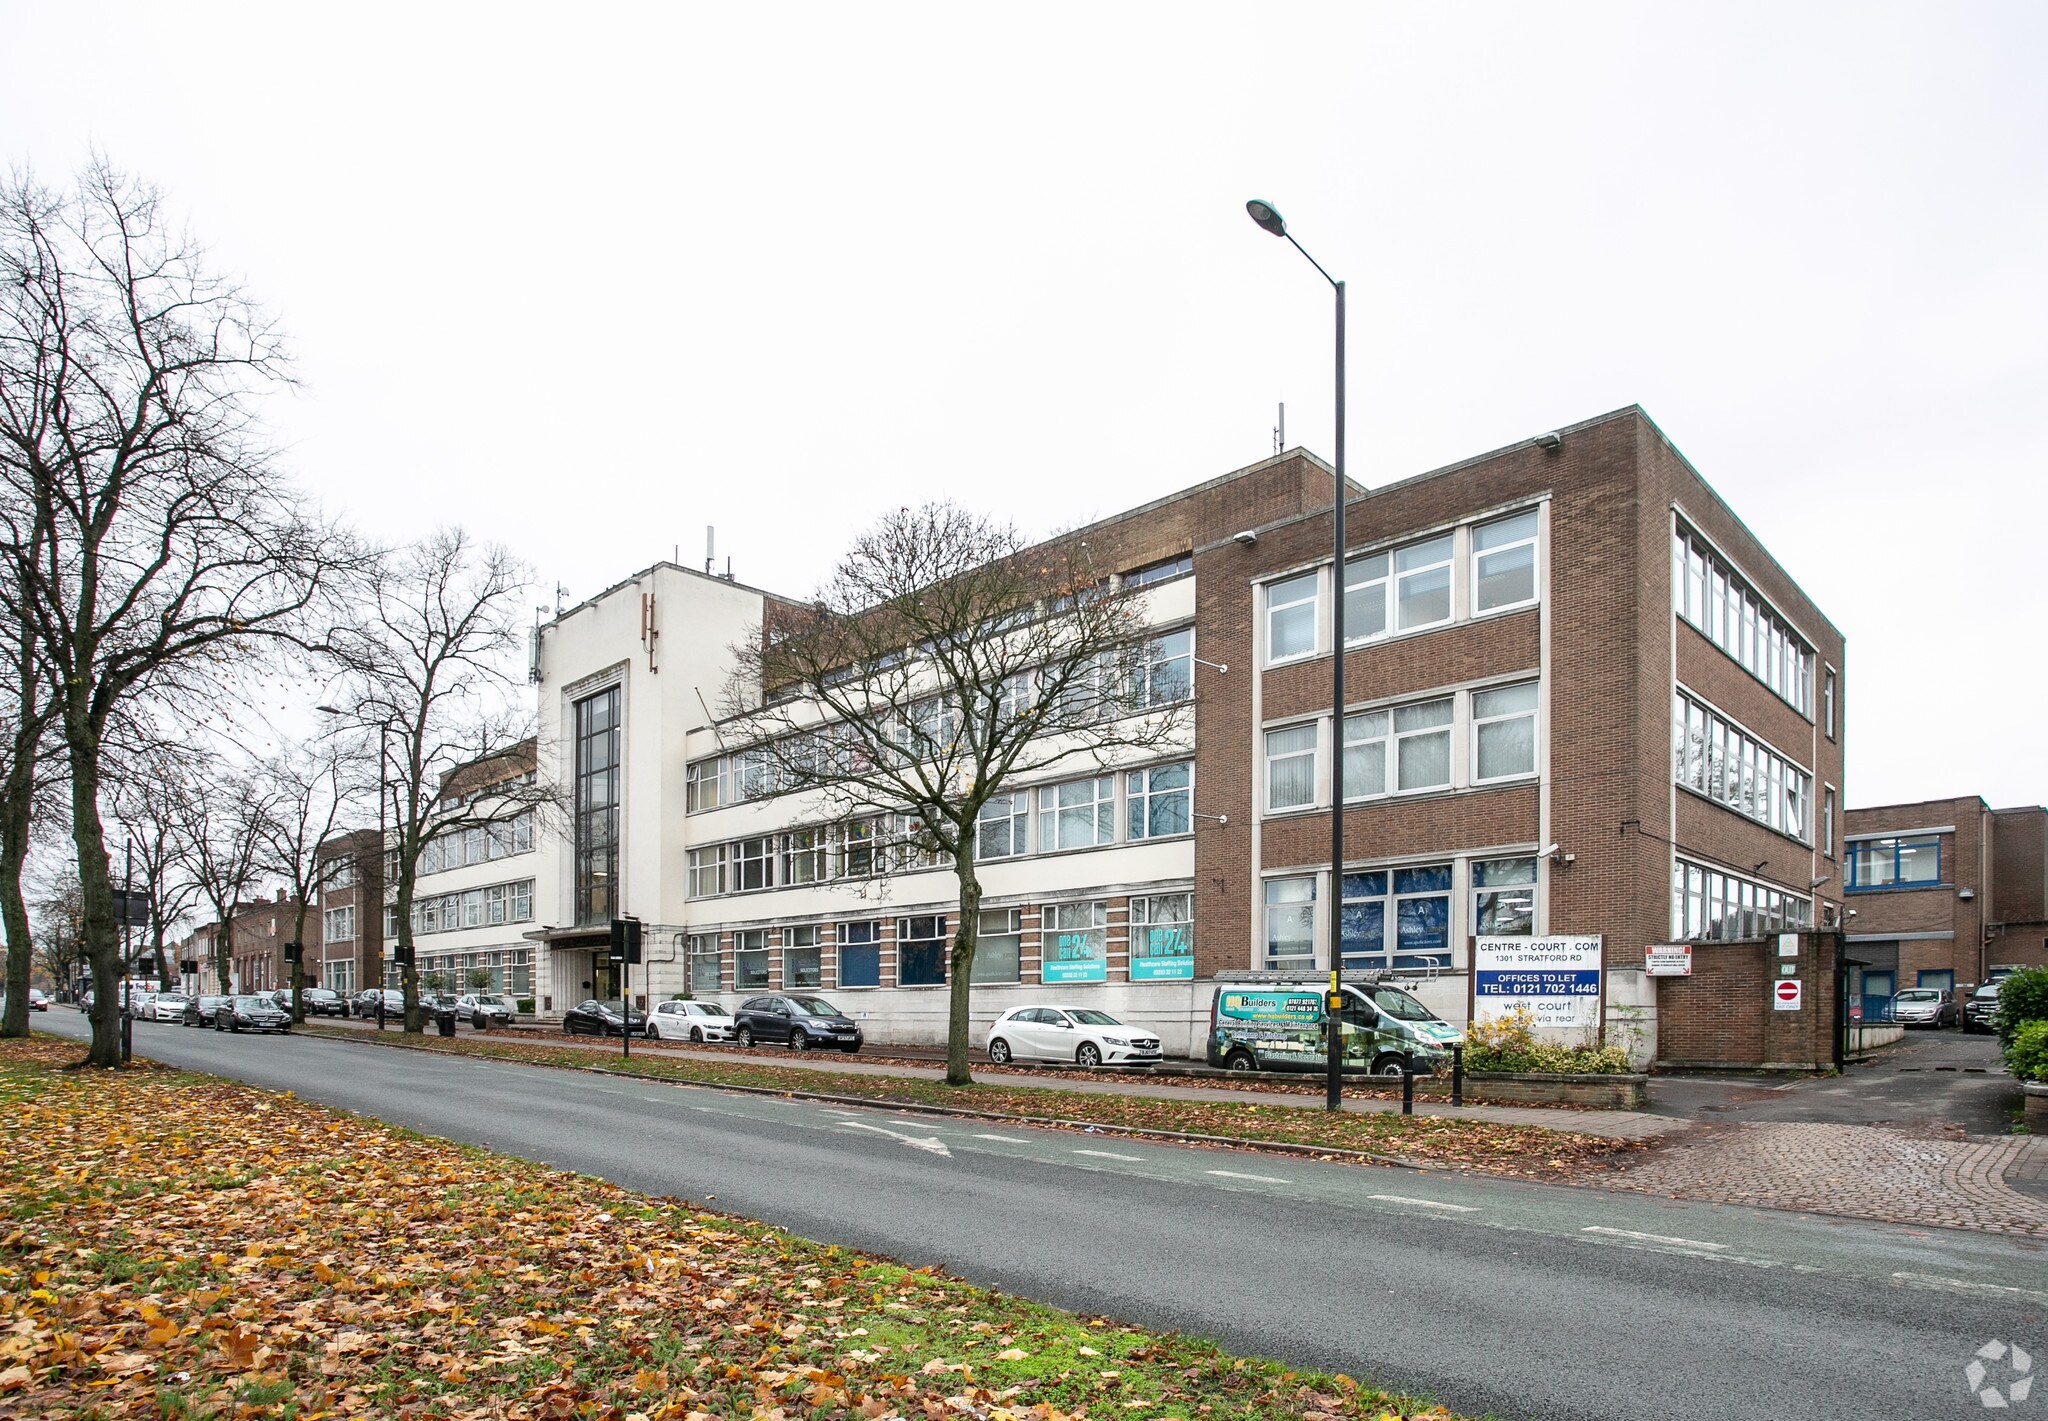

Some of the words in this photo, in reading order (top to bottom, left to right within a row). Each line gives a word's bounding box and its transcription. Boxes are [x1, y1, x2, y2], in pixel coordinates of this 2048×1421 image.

[1149, 929, 1163, 942] one
[1400, 926, 1424, 936] Ashley
[1058, 934, 1071, 947] one
[1480, 943, 1521, 951] CENTRE
[1530, 942, 1566, 951] COURT
[1574, 942, 1598, 950] COM
[1498, 974, 1540, 982] OFFICES
[136, 982, 155, 990] FedEx
[1482, 984, 1510, 994] TEL:
[1512, 984, 1540, 994] 0121
[1544, 984, 1565, 994] 702
[1569, 984, 1597, 994] 1446
[1242, 996, 1276, 1008] Builders
[1503, 1001, 1531, 1011] west
[1537, 1002, 1571, 1011] court
[1538, 1014, 1551, 1022] via
[1236, 1020, 1257, 1029] Building
[1285, 1022, 1318, 1030] Maintenance
